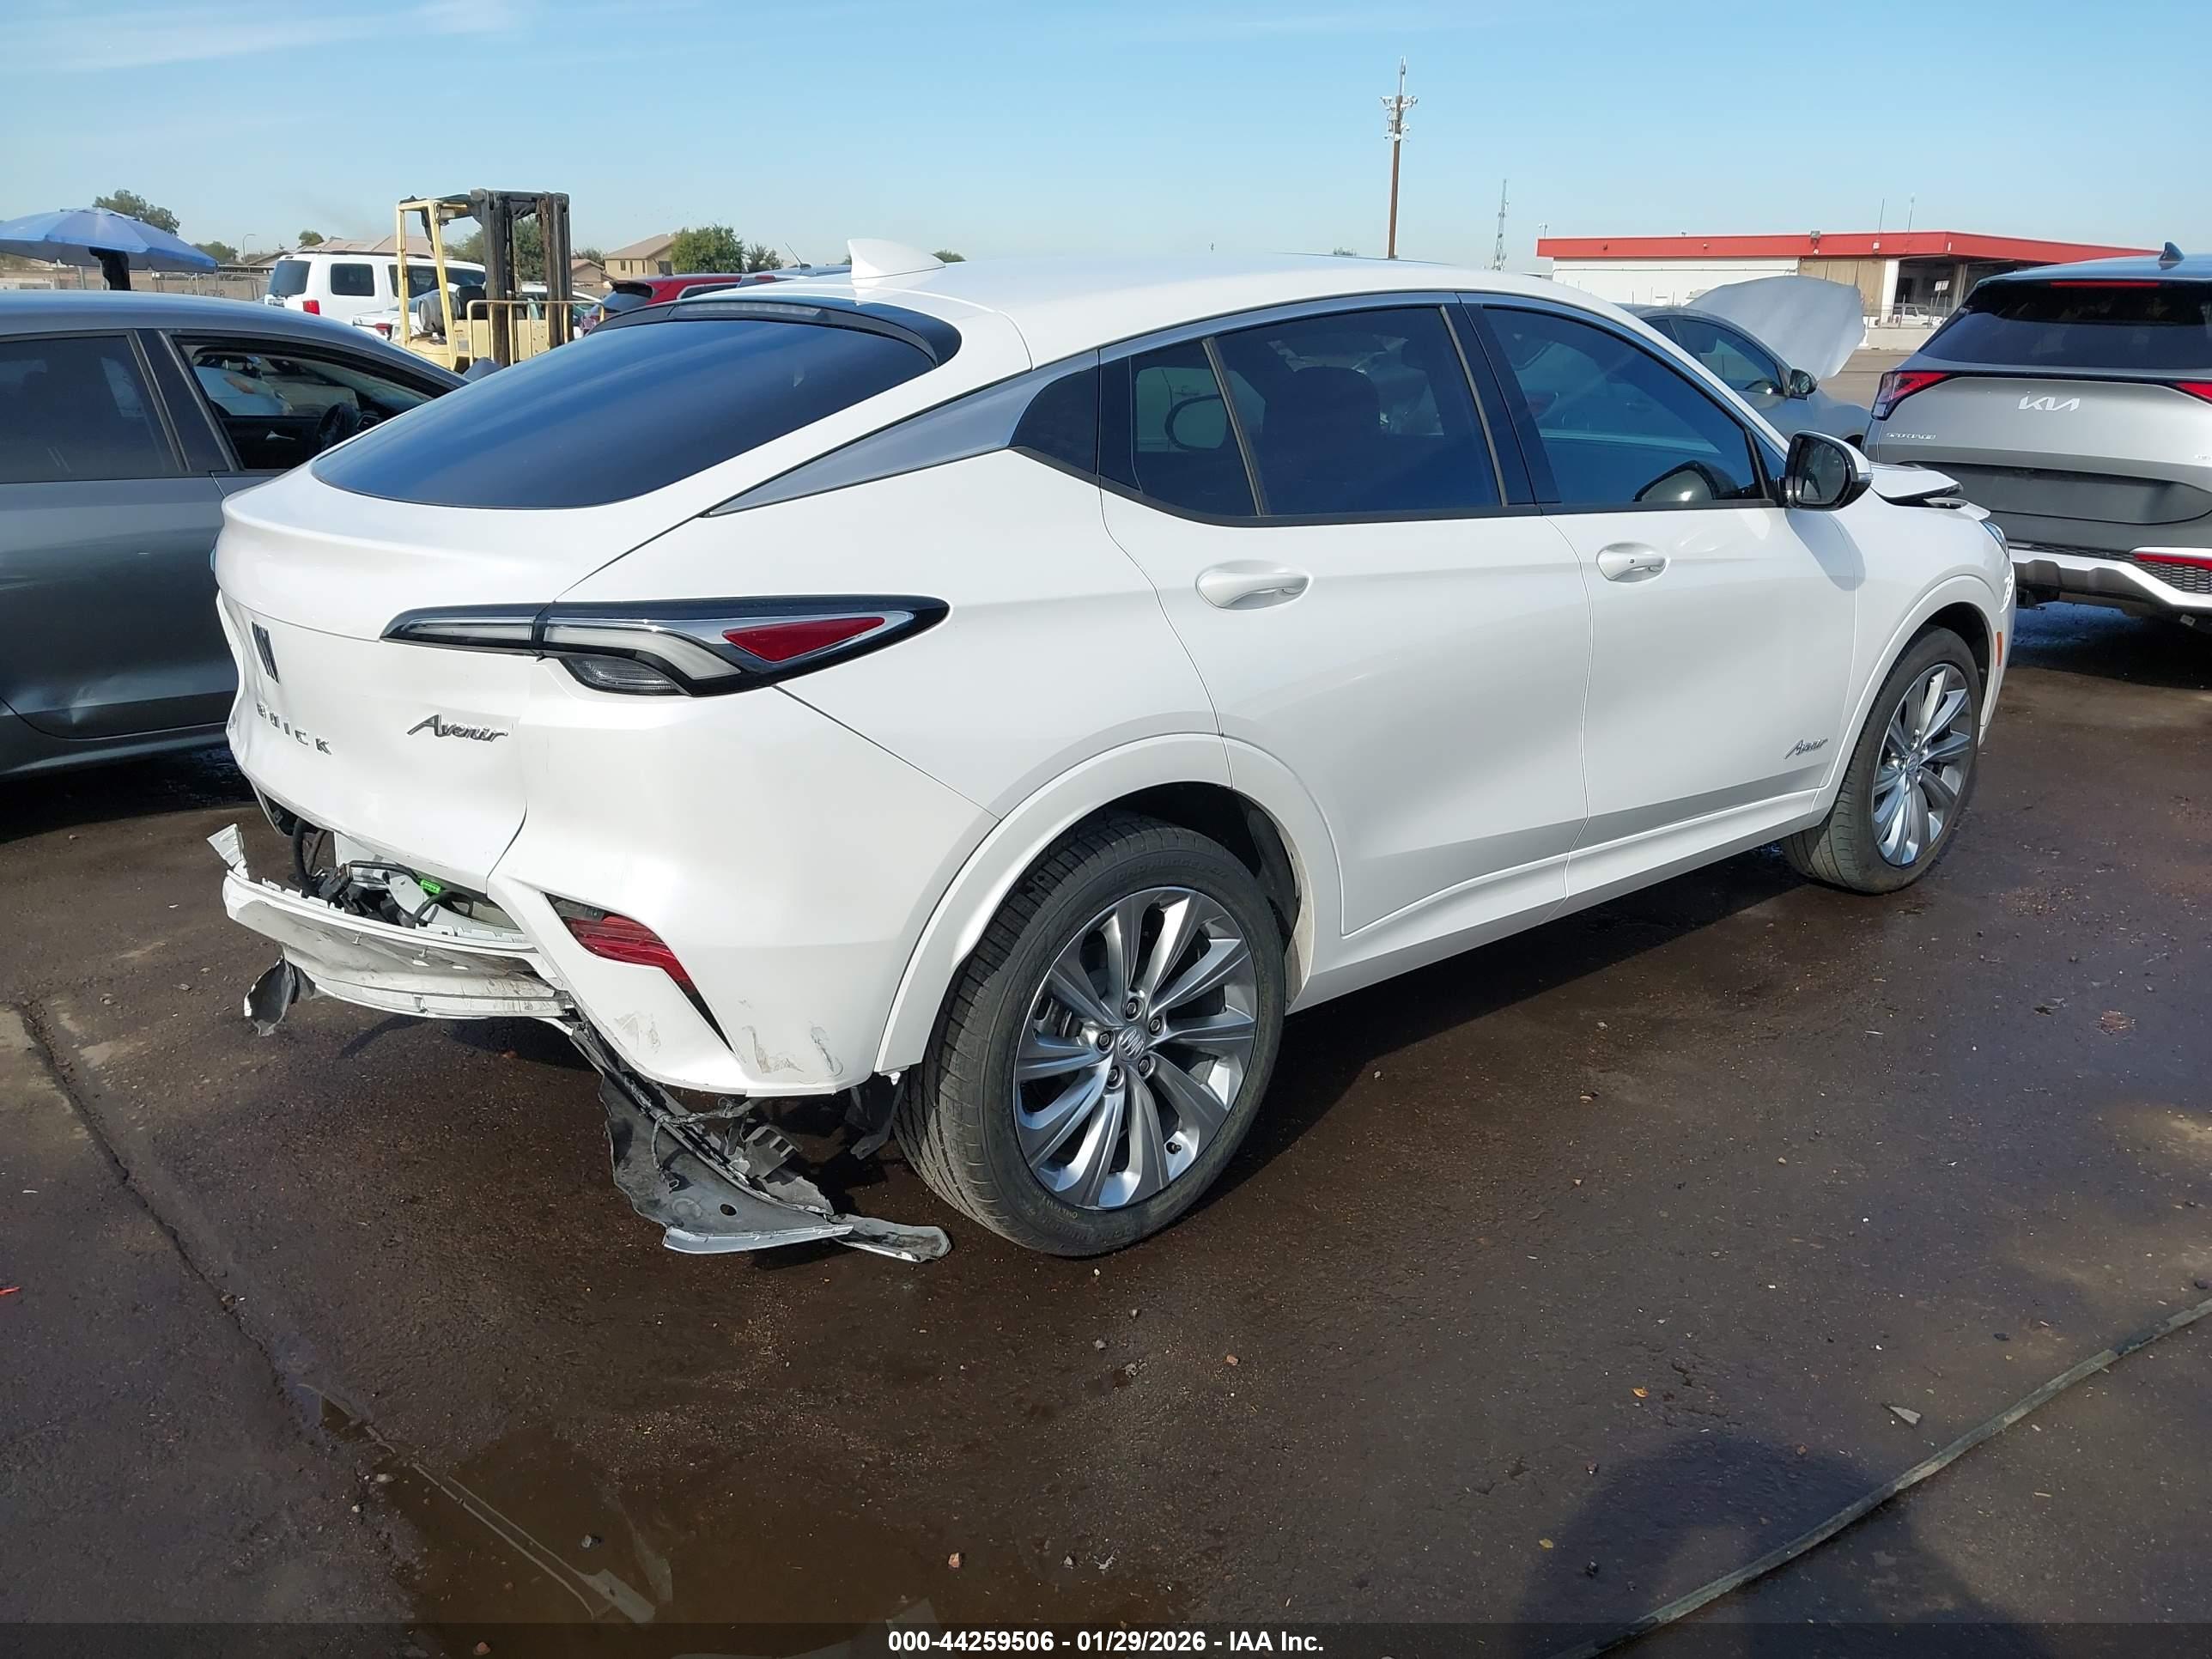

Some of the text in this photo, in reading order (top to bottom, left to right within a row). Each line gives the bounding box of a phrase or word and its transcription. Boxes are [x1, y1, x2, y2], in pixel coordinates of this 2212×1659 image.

[2018, 395, 2081, 412] KIA
[256, 701, 332, 755] BUICK
[407, 714, 508, 742] Avenir
